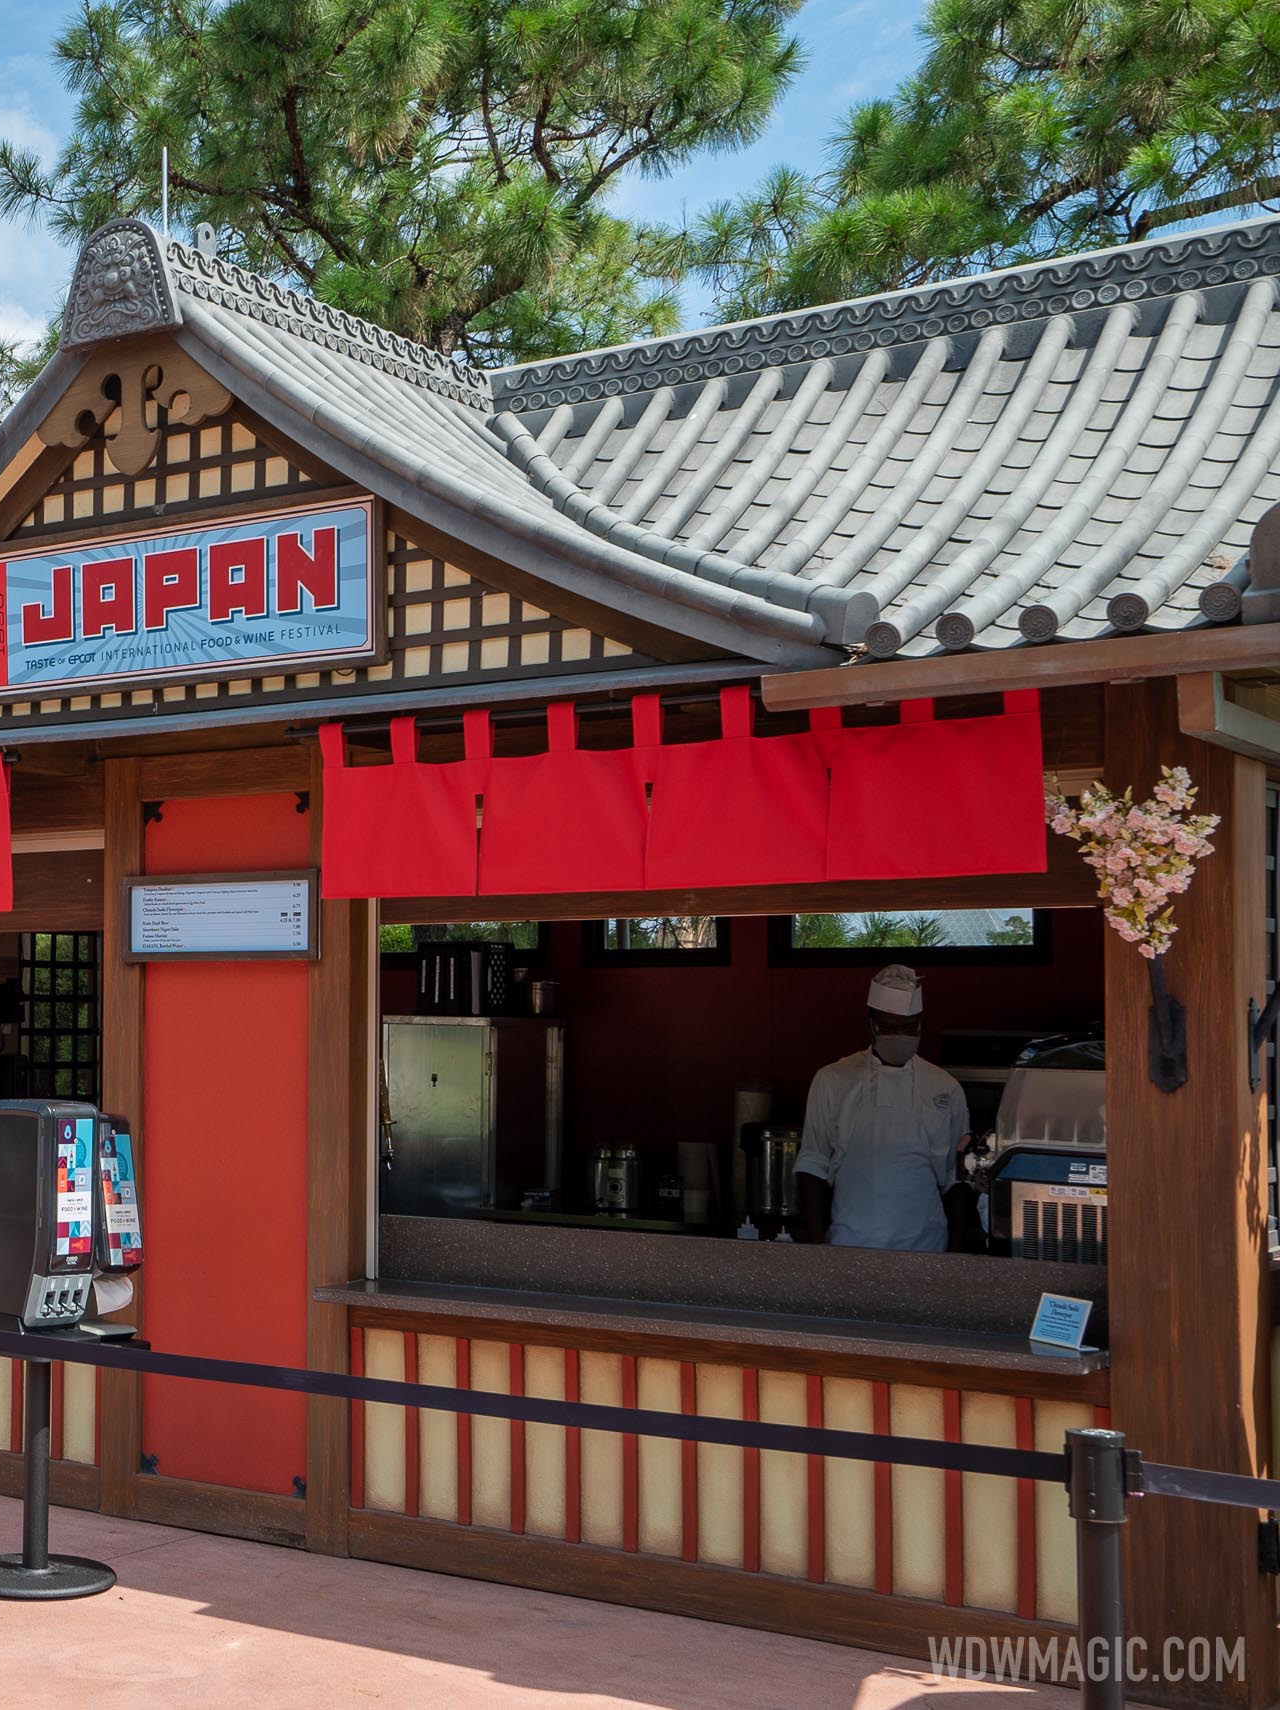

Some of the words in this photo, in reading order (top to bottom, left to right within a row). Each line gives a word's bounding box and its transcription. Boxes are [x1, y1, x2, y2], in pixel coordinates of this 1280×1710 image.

[22, 526, 340, 647] JAPAN
[25, 657, 55, 670] TASTE
[68, 652, 96, 665] EPCOT
[101, 641, 196, 661] INTERNATIONAL
[200, 636, 233, 650] FOOD
[234, 636, 241, 645] &
[243, 631, 276, 644] WINE
[281, 623, 342, 640] FESTIVAL
